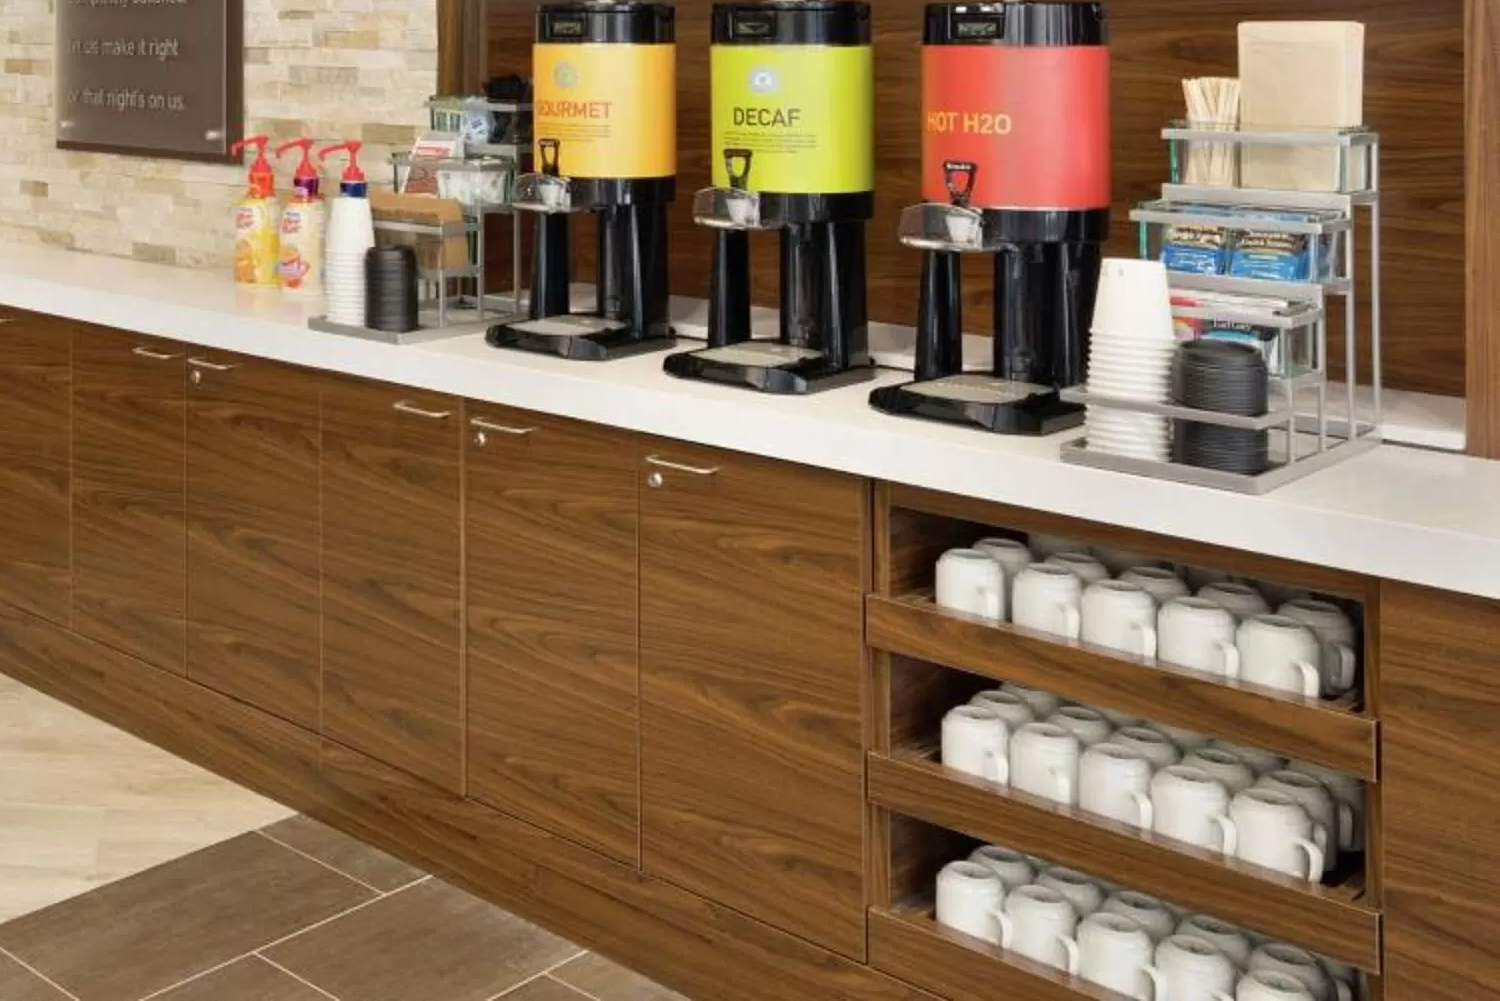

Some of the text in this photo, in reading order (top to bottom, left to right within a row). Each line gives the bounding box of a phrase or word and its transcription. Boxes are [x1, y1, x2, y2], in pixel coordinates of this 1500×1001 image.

[138, 39, 147, 56] it
[149, 38, 180, 62] right
[148, 94, 165, 109] on
[733, 106, 802, 127] DECAF
[927, 111, 959, 133] HOT
